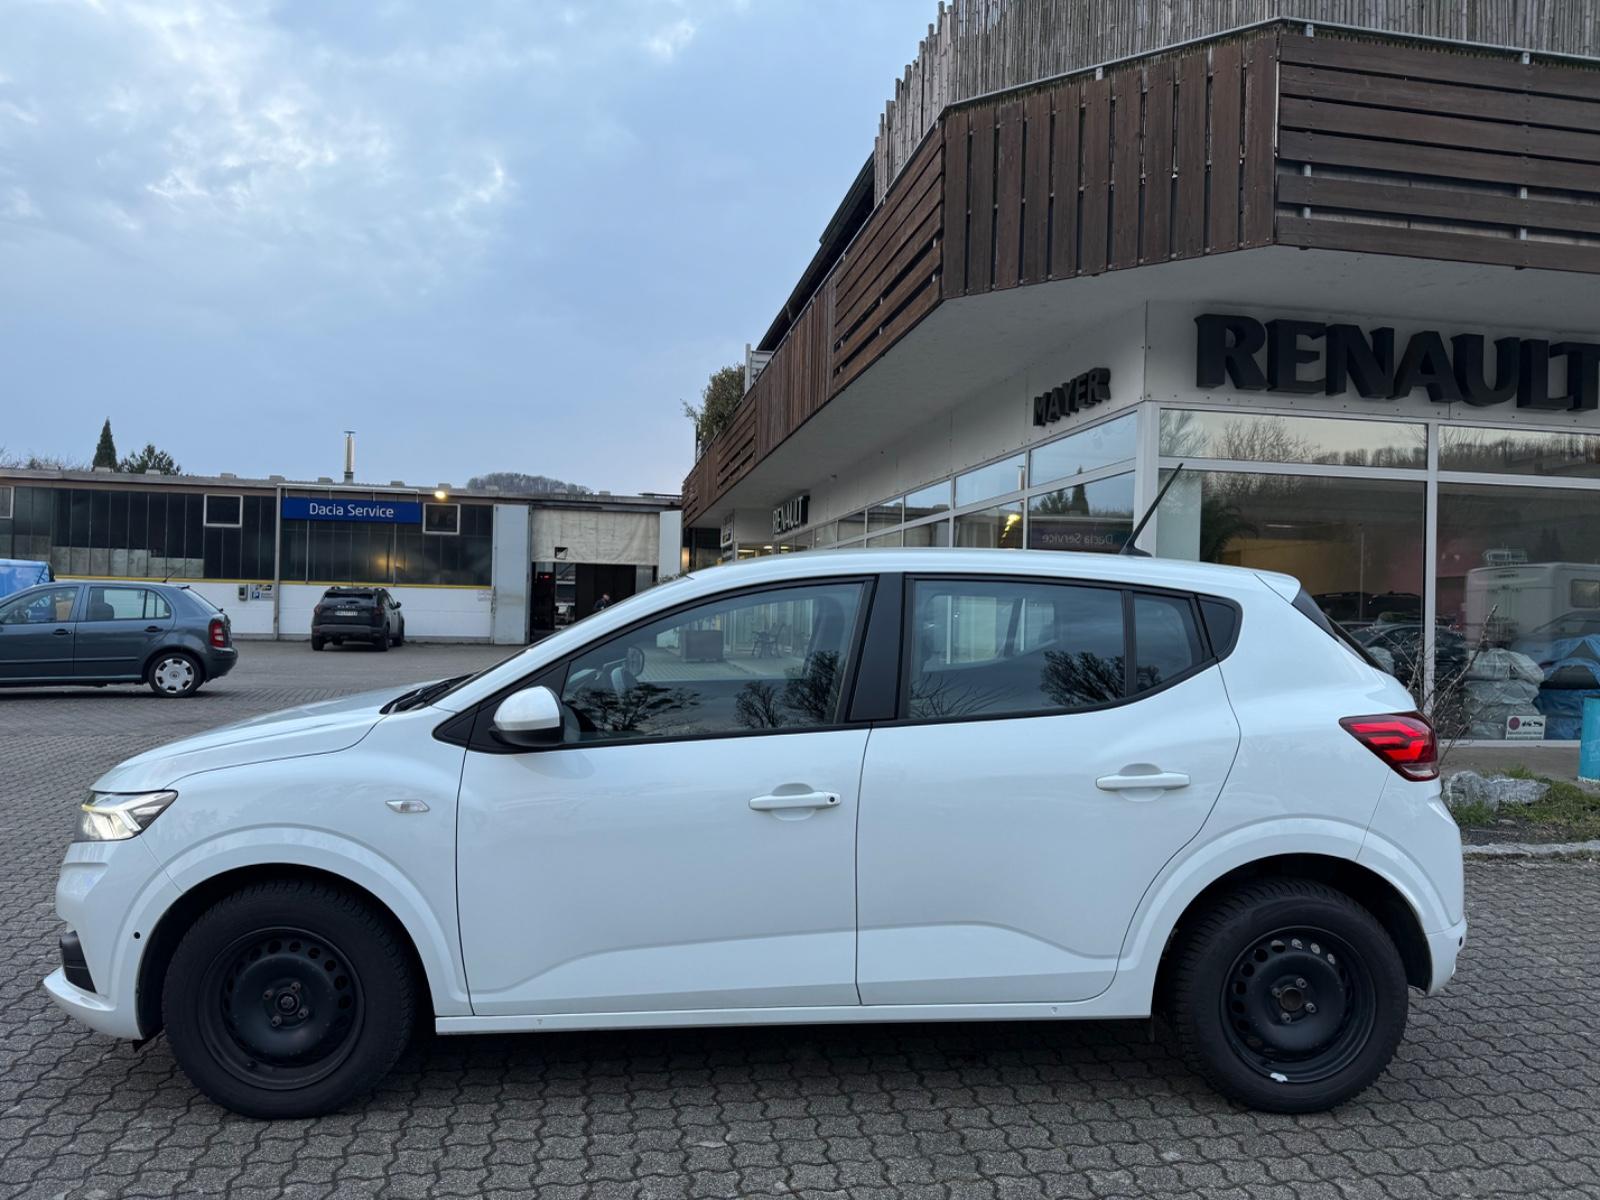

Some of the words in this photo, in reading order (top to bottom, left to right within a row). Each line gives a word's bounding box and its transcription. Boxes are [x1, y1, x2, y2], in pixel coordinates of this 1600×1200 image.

[1194, 313, 1600, 412] RENAULT
[1033, 367, 1111, 426] MAYER
[309, 502, 344, 516] Dacia
[347, 504, 394, 518] Service
[772, 495, 810, 535] RENAULT
